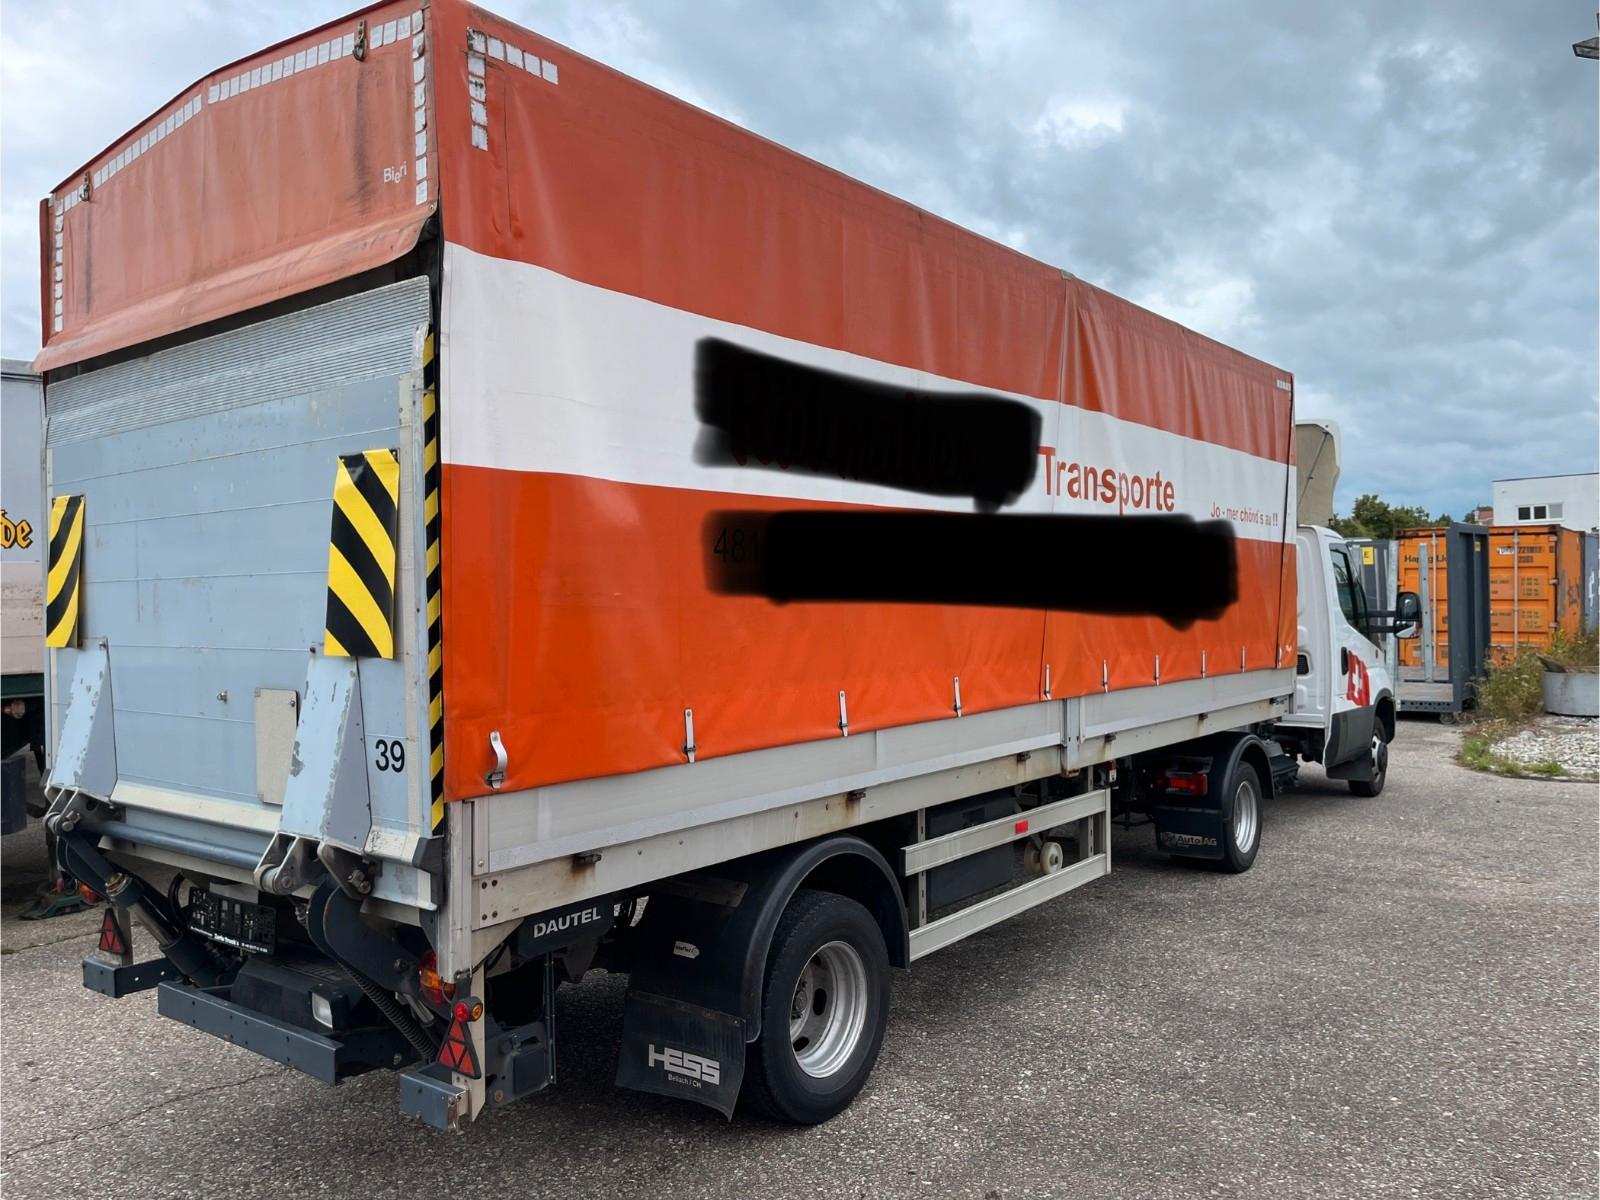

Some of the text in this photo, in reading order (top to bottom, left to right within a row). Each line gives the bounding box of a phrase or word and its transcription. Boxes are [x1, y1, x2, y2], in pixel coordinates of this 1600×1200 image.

[383, 160, 407, 184] Bieri
[1037, 446, 1175, 517] Transporte
[1211, 501, 1221, 518] Jo
[375, 739, 406, 773] 39
[533, 907, 601, 938] DAUTEL
[648, 1044, 720, 1086] HESS
